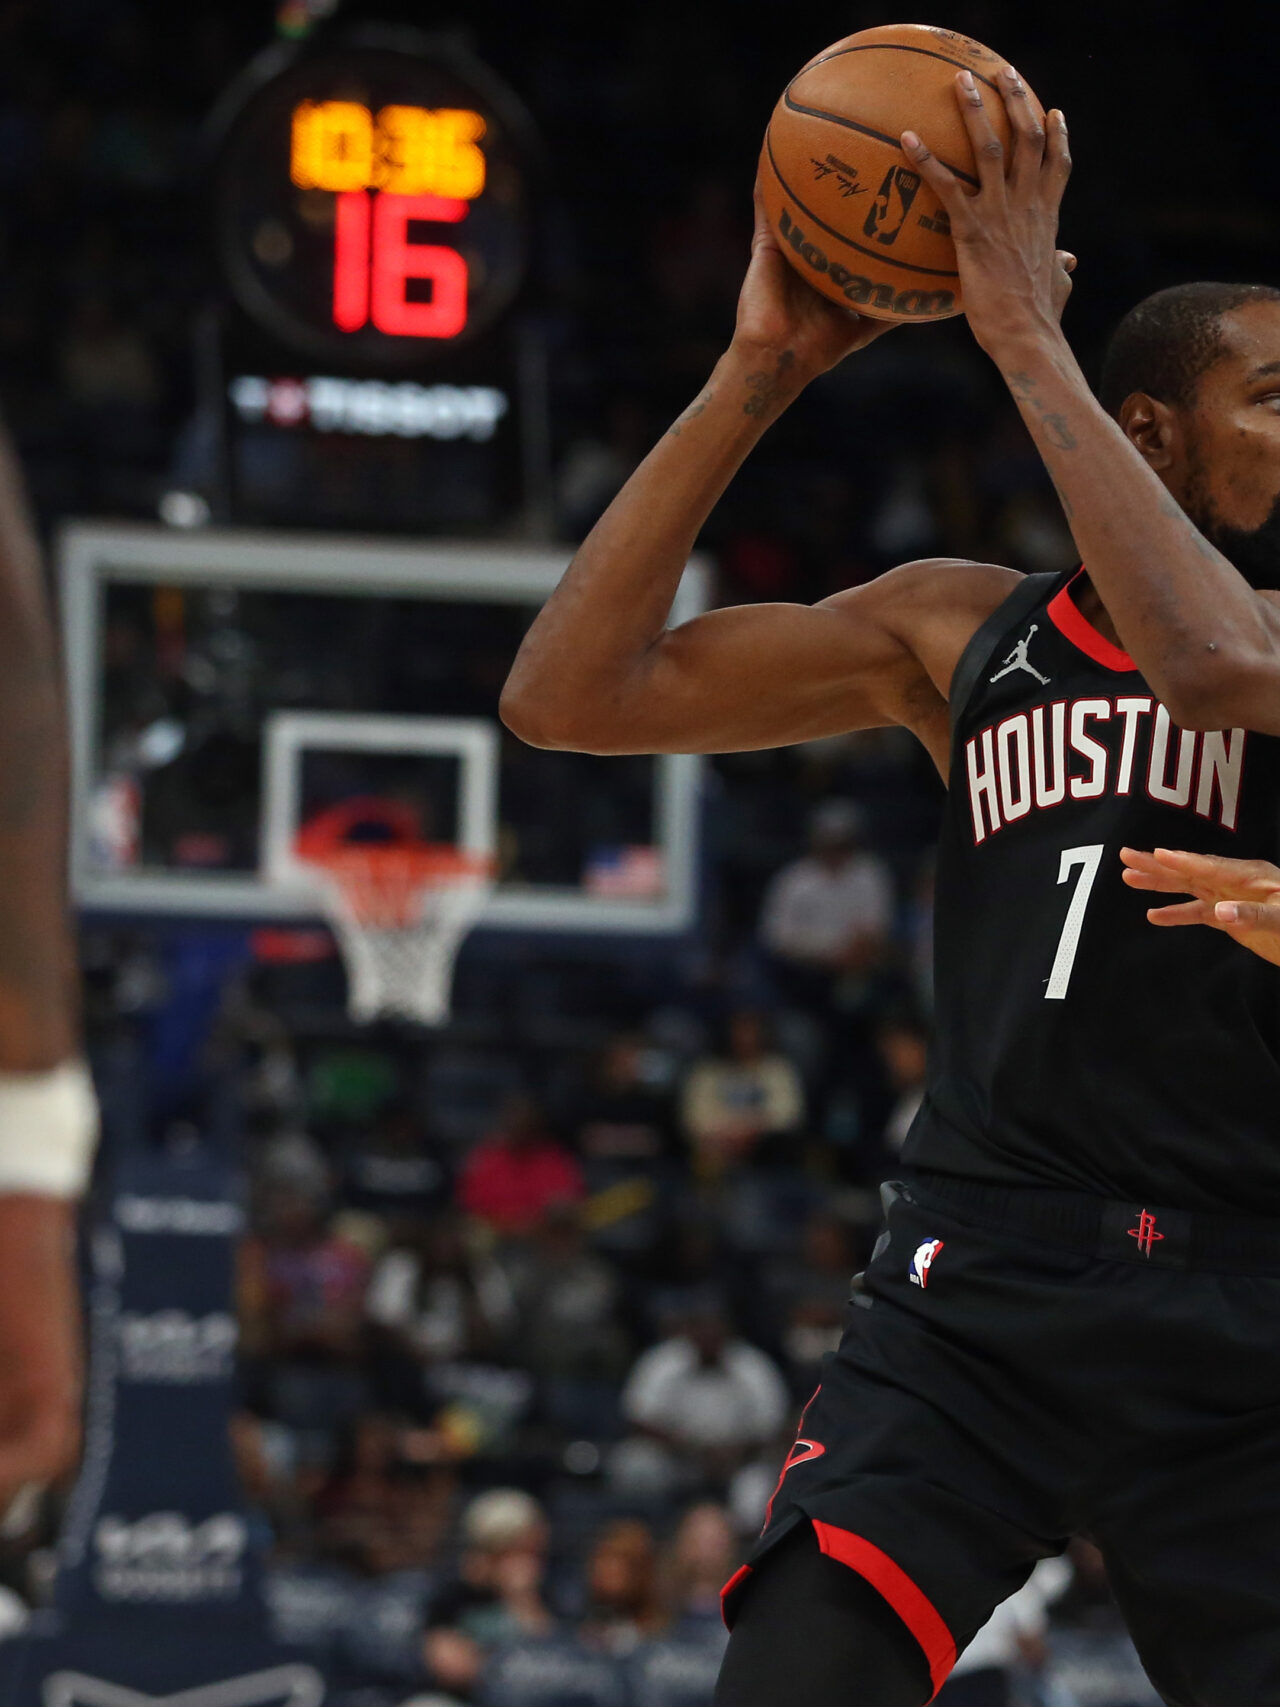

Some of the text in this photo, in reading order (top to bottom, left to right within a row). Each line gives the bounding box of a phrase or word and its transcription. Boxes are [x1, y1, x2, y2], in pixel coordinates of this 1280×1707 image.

[333, 188, 468, 338] 16
[966, 695, 1246, 846] HOUSTON
[1043, 844, 1104, 1000] 7
